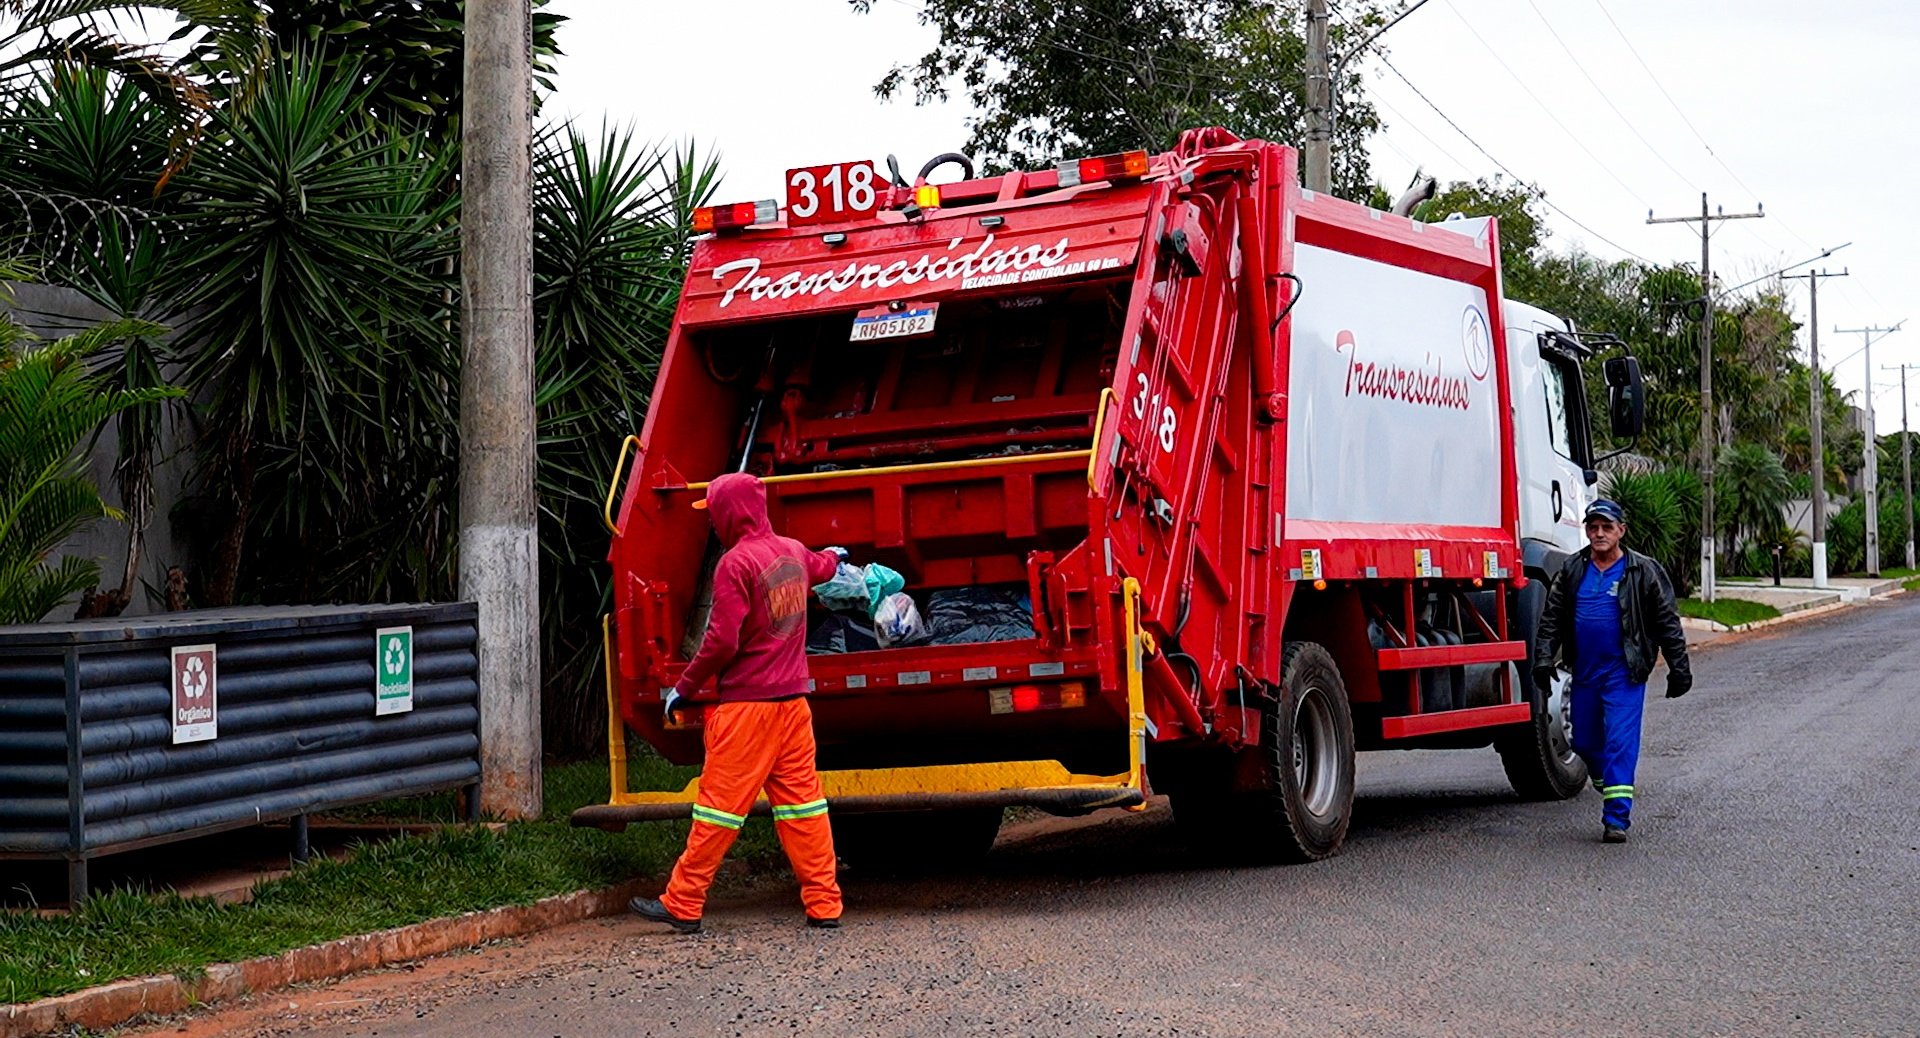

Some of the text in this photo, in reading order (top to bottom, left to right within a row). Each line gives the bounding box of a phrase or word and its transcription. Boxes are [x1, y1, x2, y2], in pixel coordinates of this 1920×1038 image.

[790, 163, 876, 218] 318
[712, 233, 1071, 307] Transresíduos
[961, 271, 1021, 290] VELOCIDADE
[1021, 261, 1086, 282] CONTROLADA
[1336, 329, 1471, 411] Transresíduos
[178, 706, 212, 724] Orgânico
